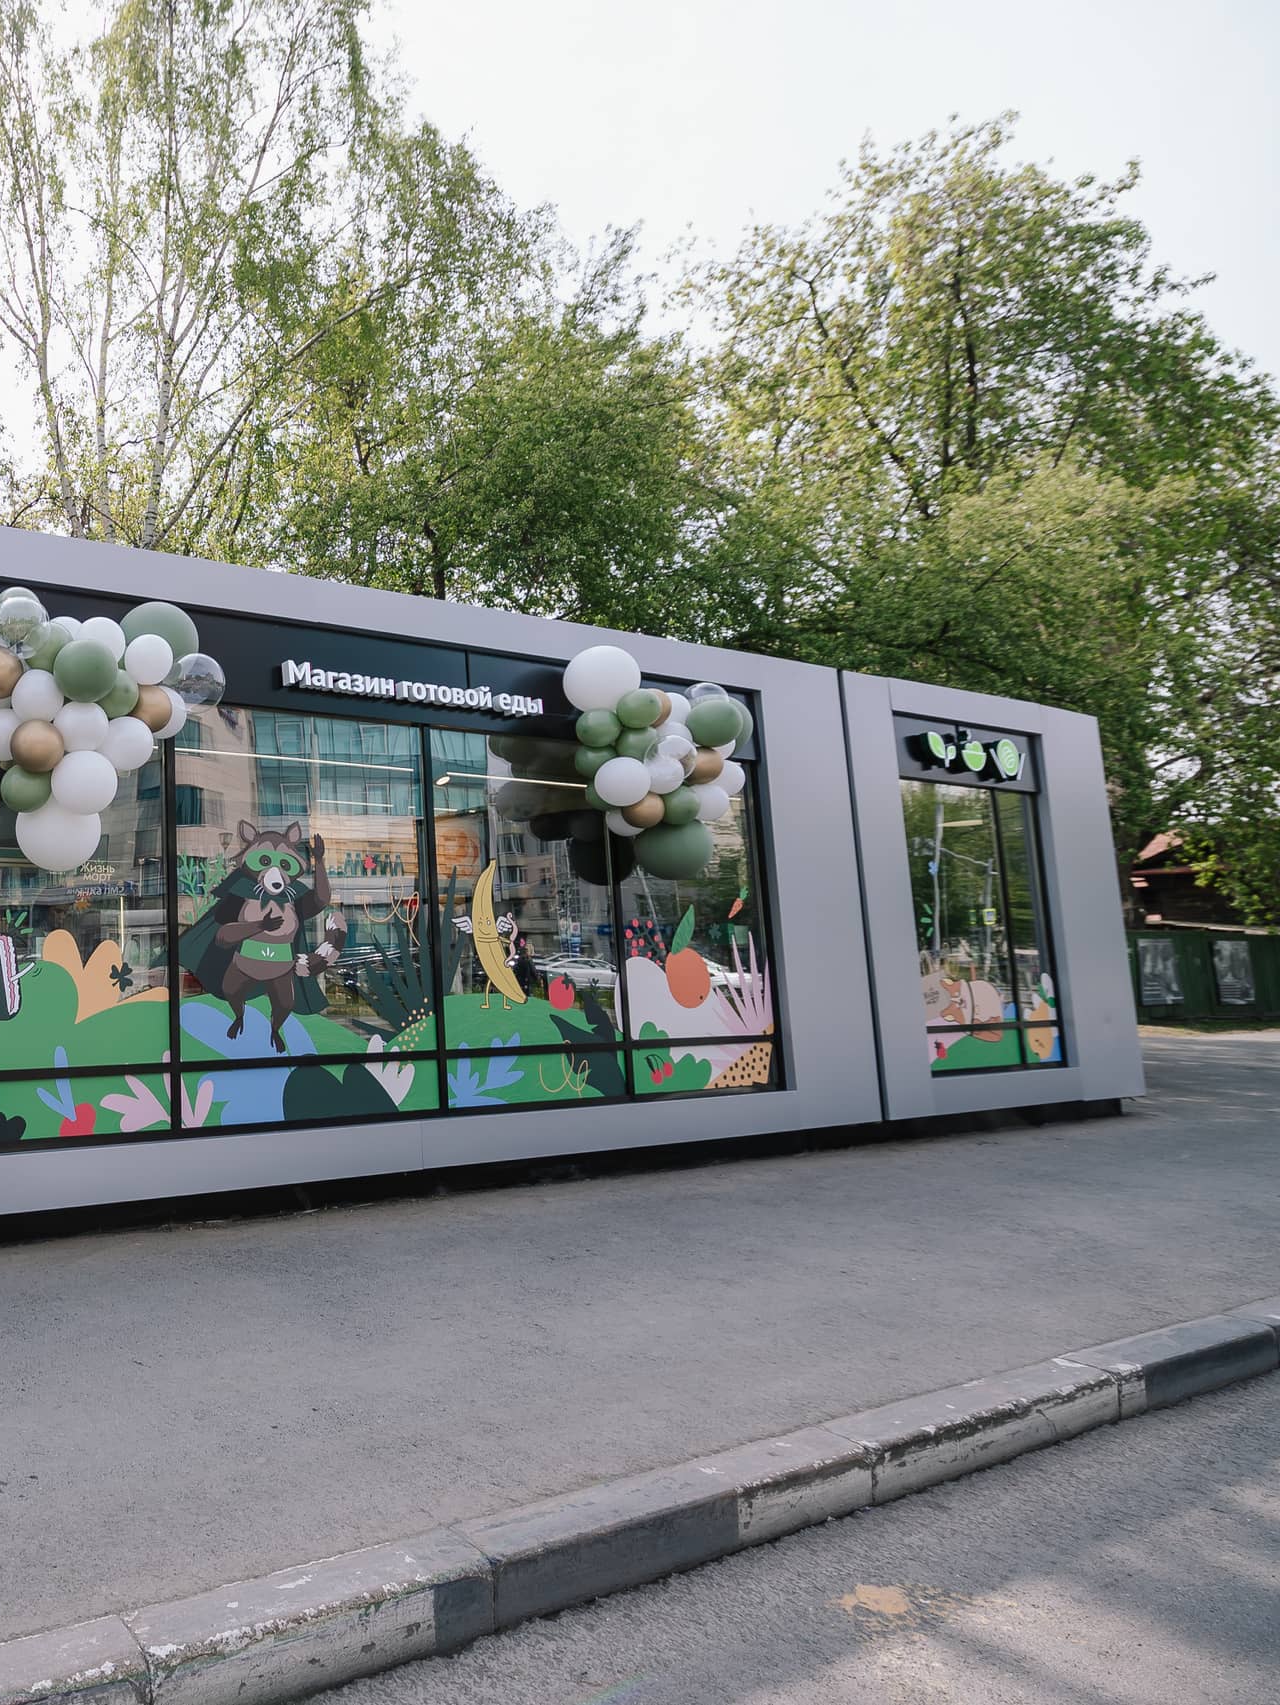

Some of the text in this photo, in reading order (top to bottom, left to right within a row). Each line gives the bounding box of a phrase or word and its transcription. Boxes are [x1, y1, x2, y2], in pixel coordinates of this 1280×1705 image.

[282, 659, 544, 717] Магазин готовой еды
[80, 862, 115, 873] Жизнь
